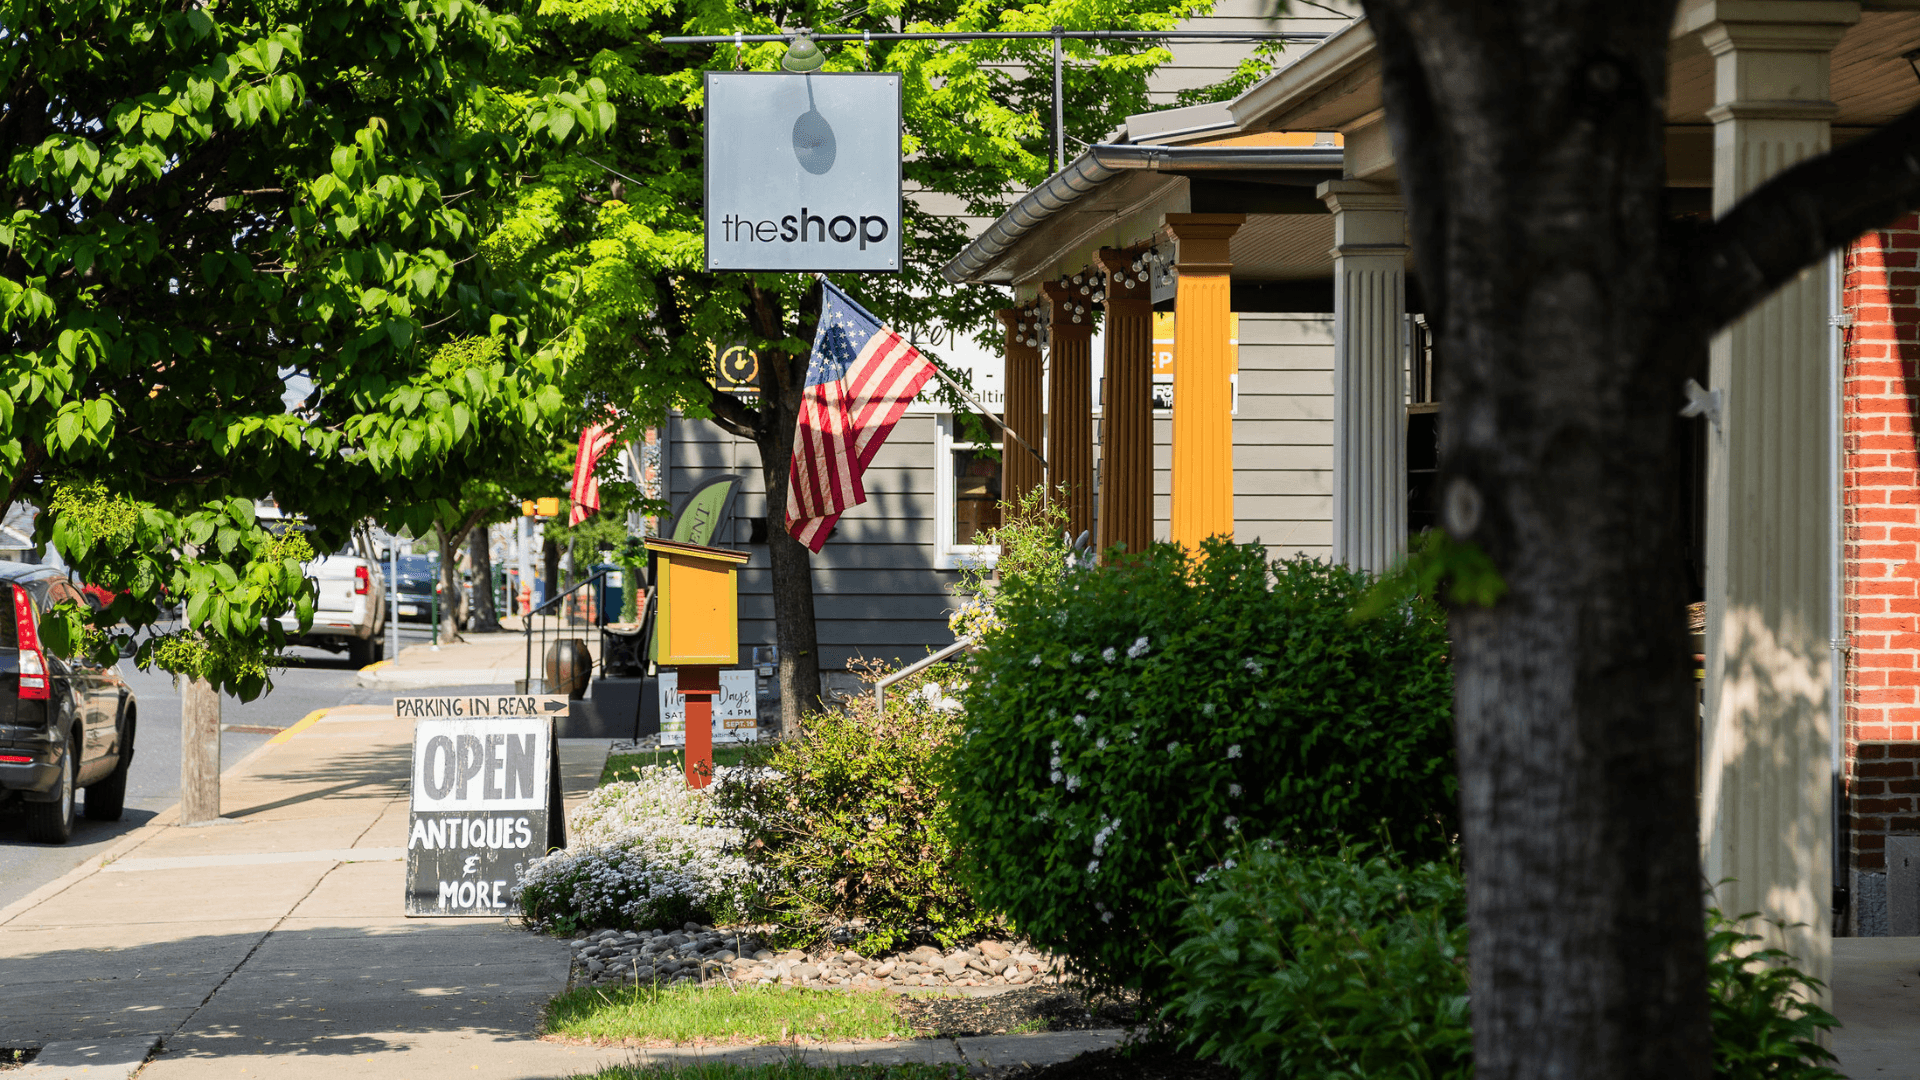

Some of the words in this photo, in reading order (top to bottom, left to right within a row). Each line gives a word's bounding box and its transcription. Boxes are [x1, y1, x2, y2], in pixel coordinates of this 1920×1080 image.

[396, 698, 464, 717] PARKING
[469, 697, 491, 716] IN
[497, 697, 538, 715] REAR
[423, 733, 536, 801] OPEN
[408, 817, 532, 850] ANTIQUES
[438, 880, 507, 909] MORE
